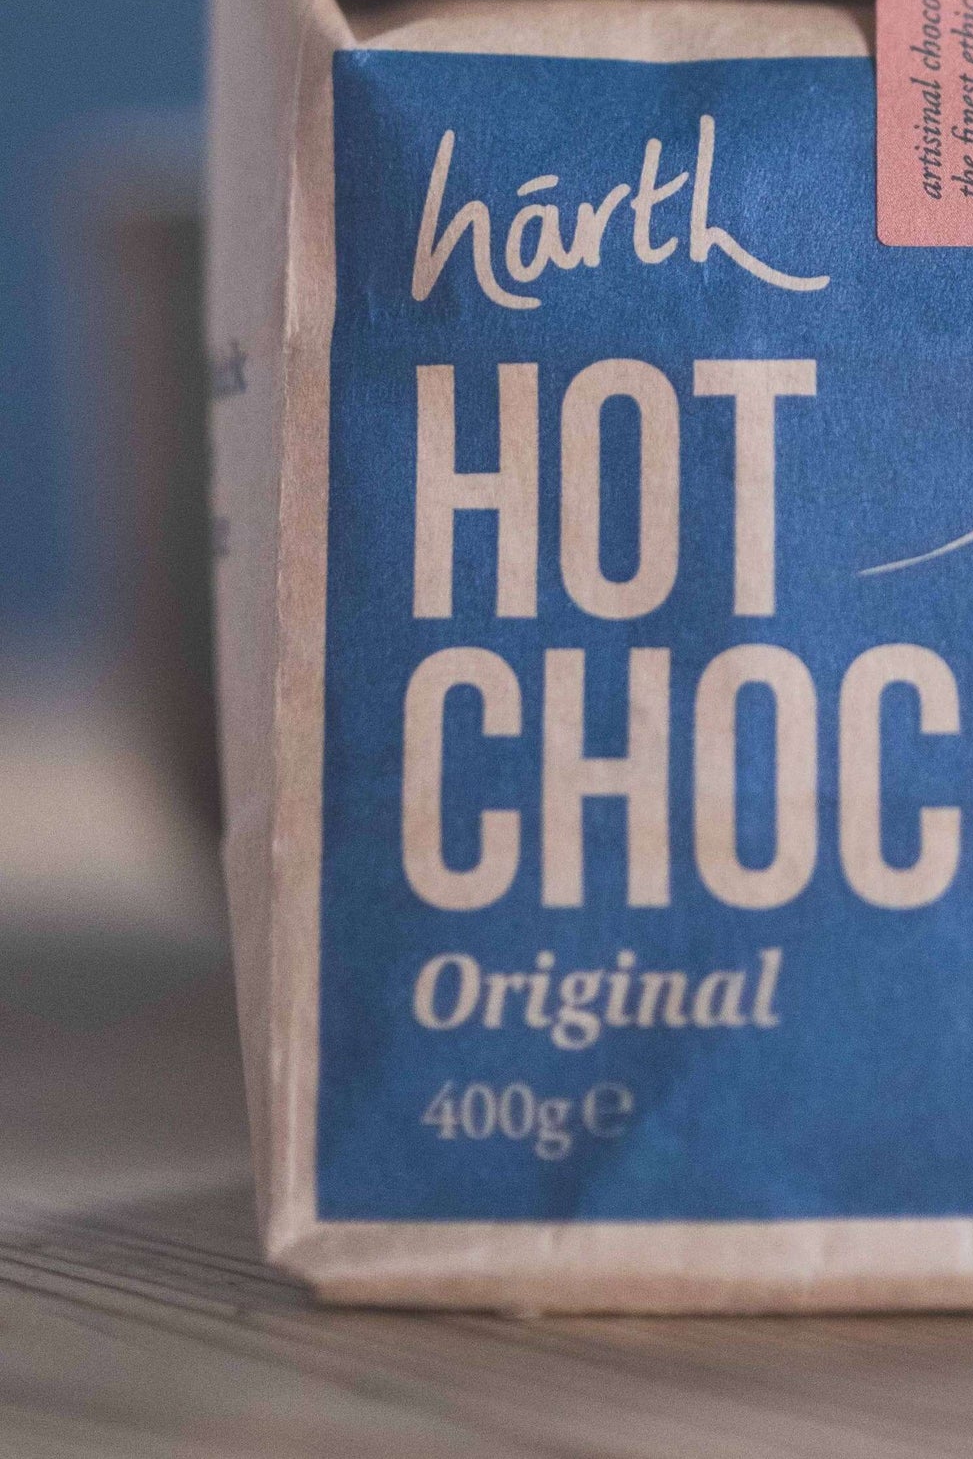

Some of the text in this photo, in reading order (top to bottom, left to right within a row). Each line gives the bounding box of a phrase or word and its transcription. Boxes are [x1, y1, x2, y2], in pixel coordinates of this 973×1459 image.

[911, 78, 942, 200] artisinal
[413, 358, 818, 620] HOT
[412, 947, 783, 1051] Original
[421, 1079, 573, 1161] 400g
